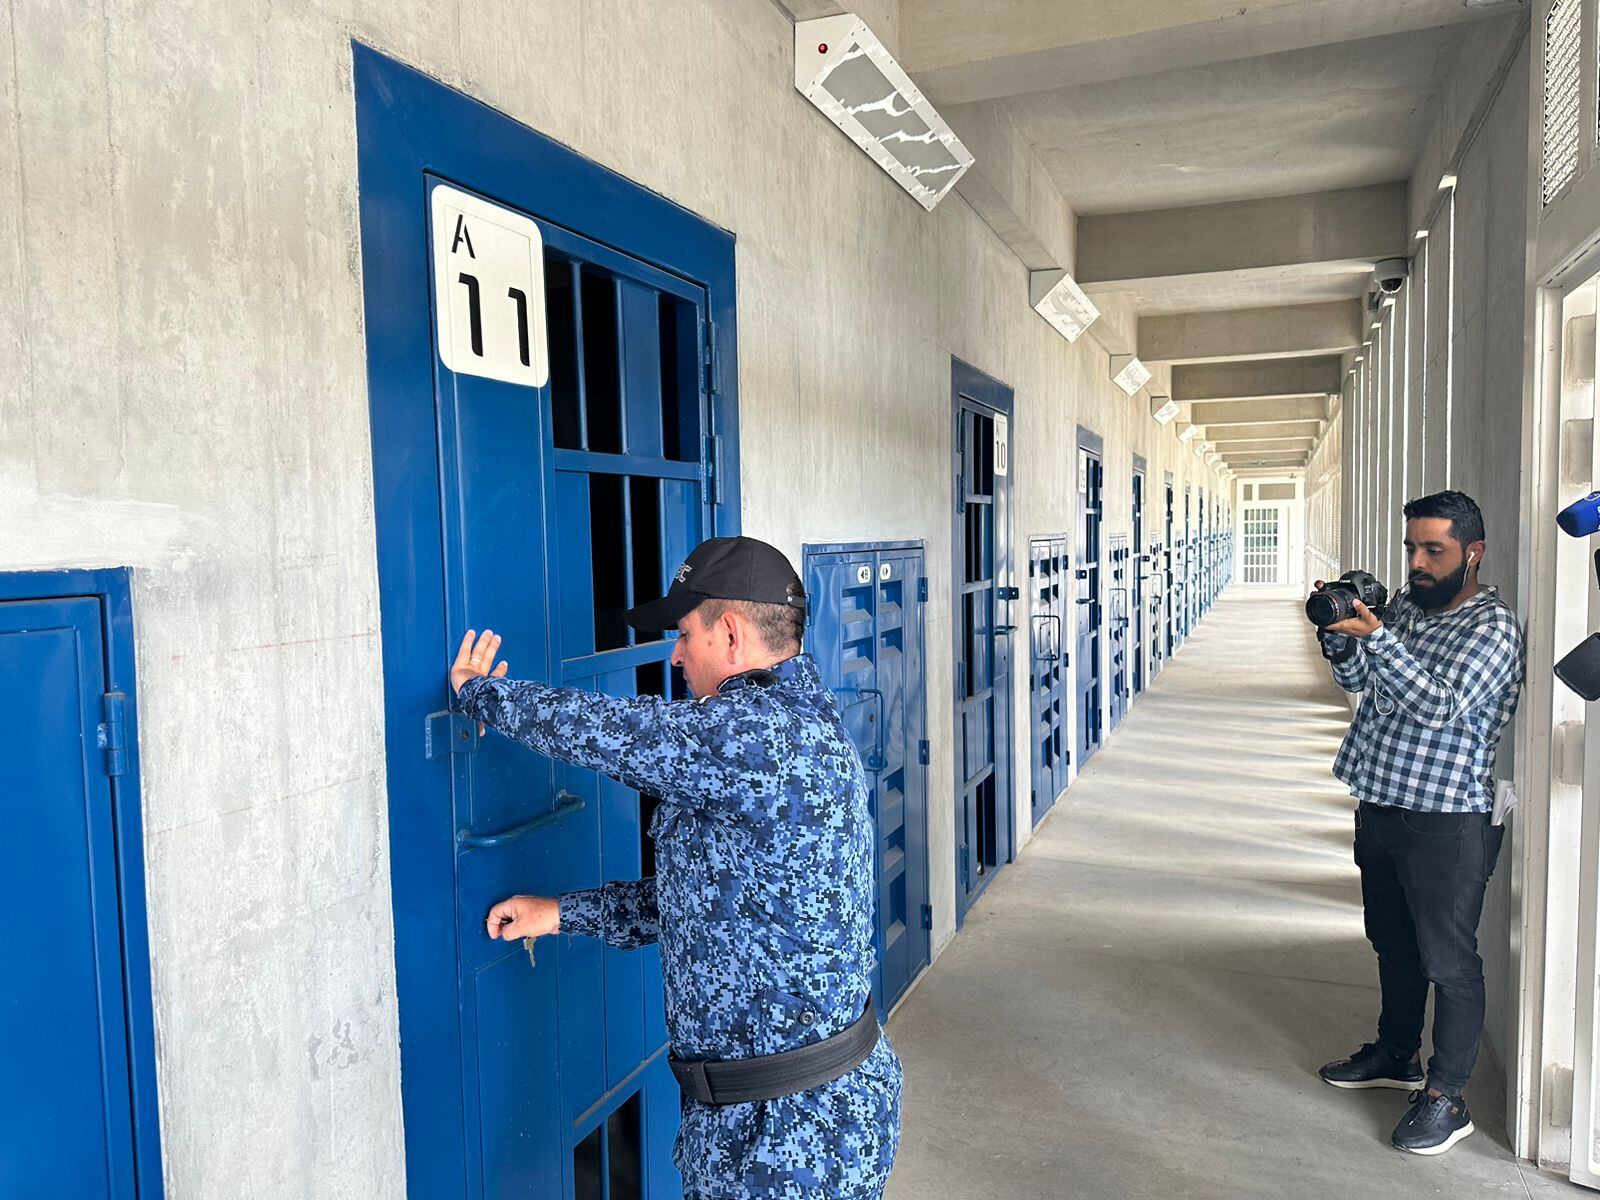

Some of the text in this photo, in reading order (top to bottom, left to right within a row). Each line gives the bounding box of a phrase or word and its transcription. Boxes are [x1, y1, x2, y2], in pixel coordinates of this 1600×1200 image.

[451, 213, 476, 260] A
[458, 271, 531, 368] 11
[996, 440, 1006, 470] 10
